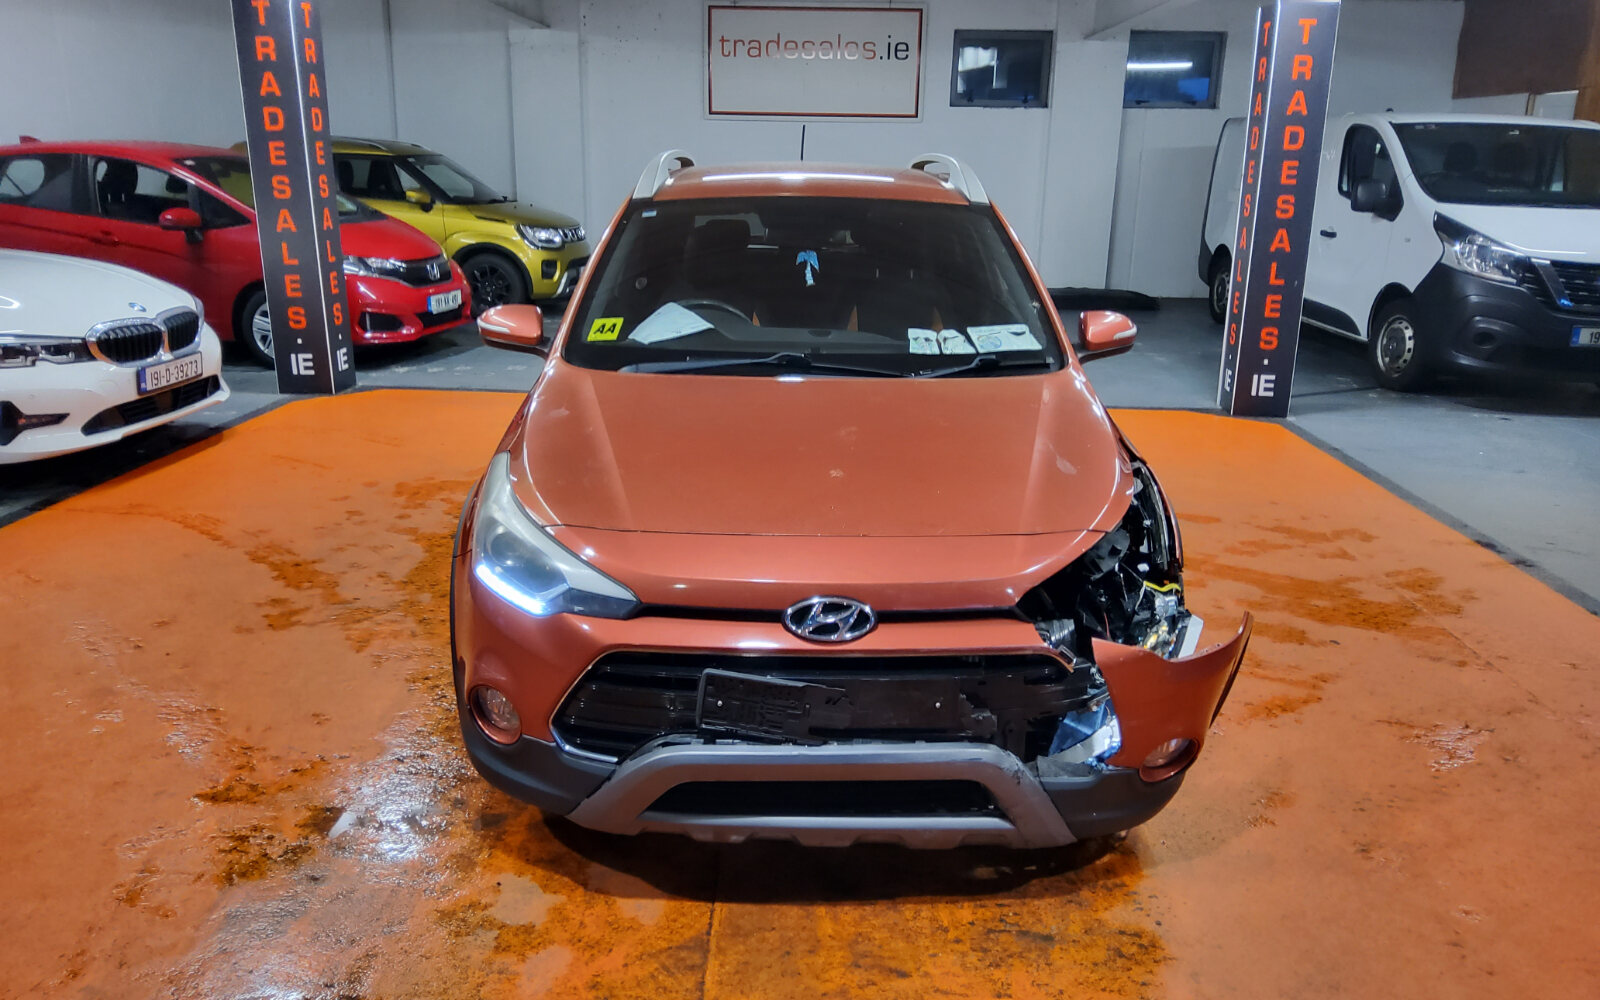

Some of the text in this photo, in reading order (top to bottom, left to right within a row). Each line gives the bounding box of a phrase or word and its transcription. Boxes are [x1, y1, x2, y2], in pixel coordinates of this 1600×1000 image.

[719, 32, 910, 61] tradesales.ie
[594, 323, 617, 334] AA
[150, 360, 199, 388] 191-D-39273
